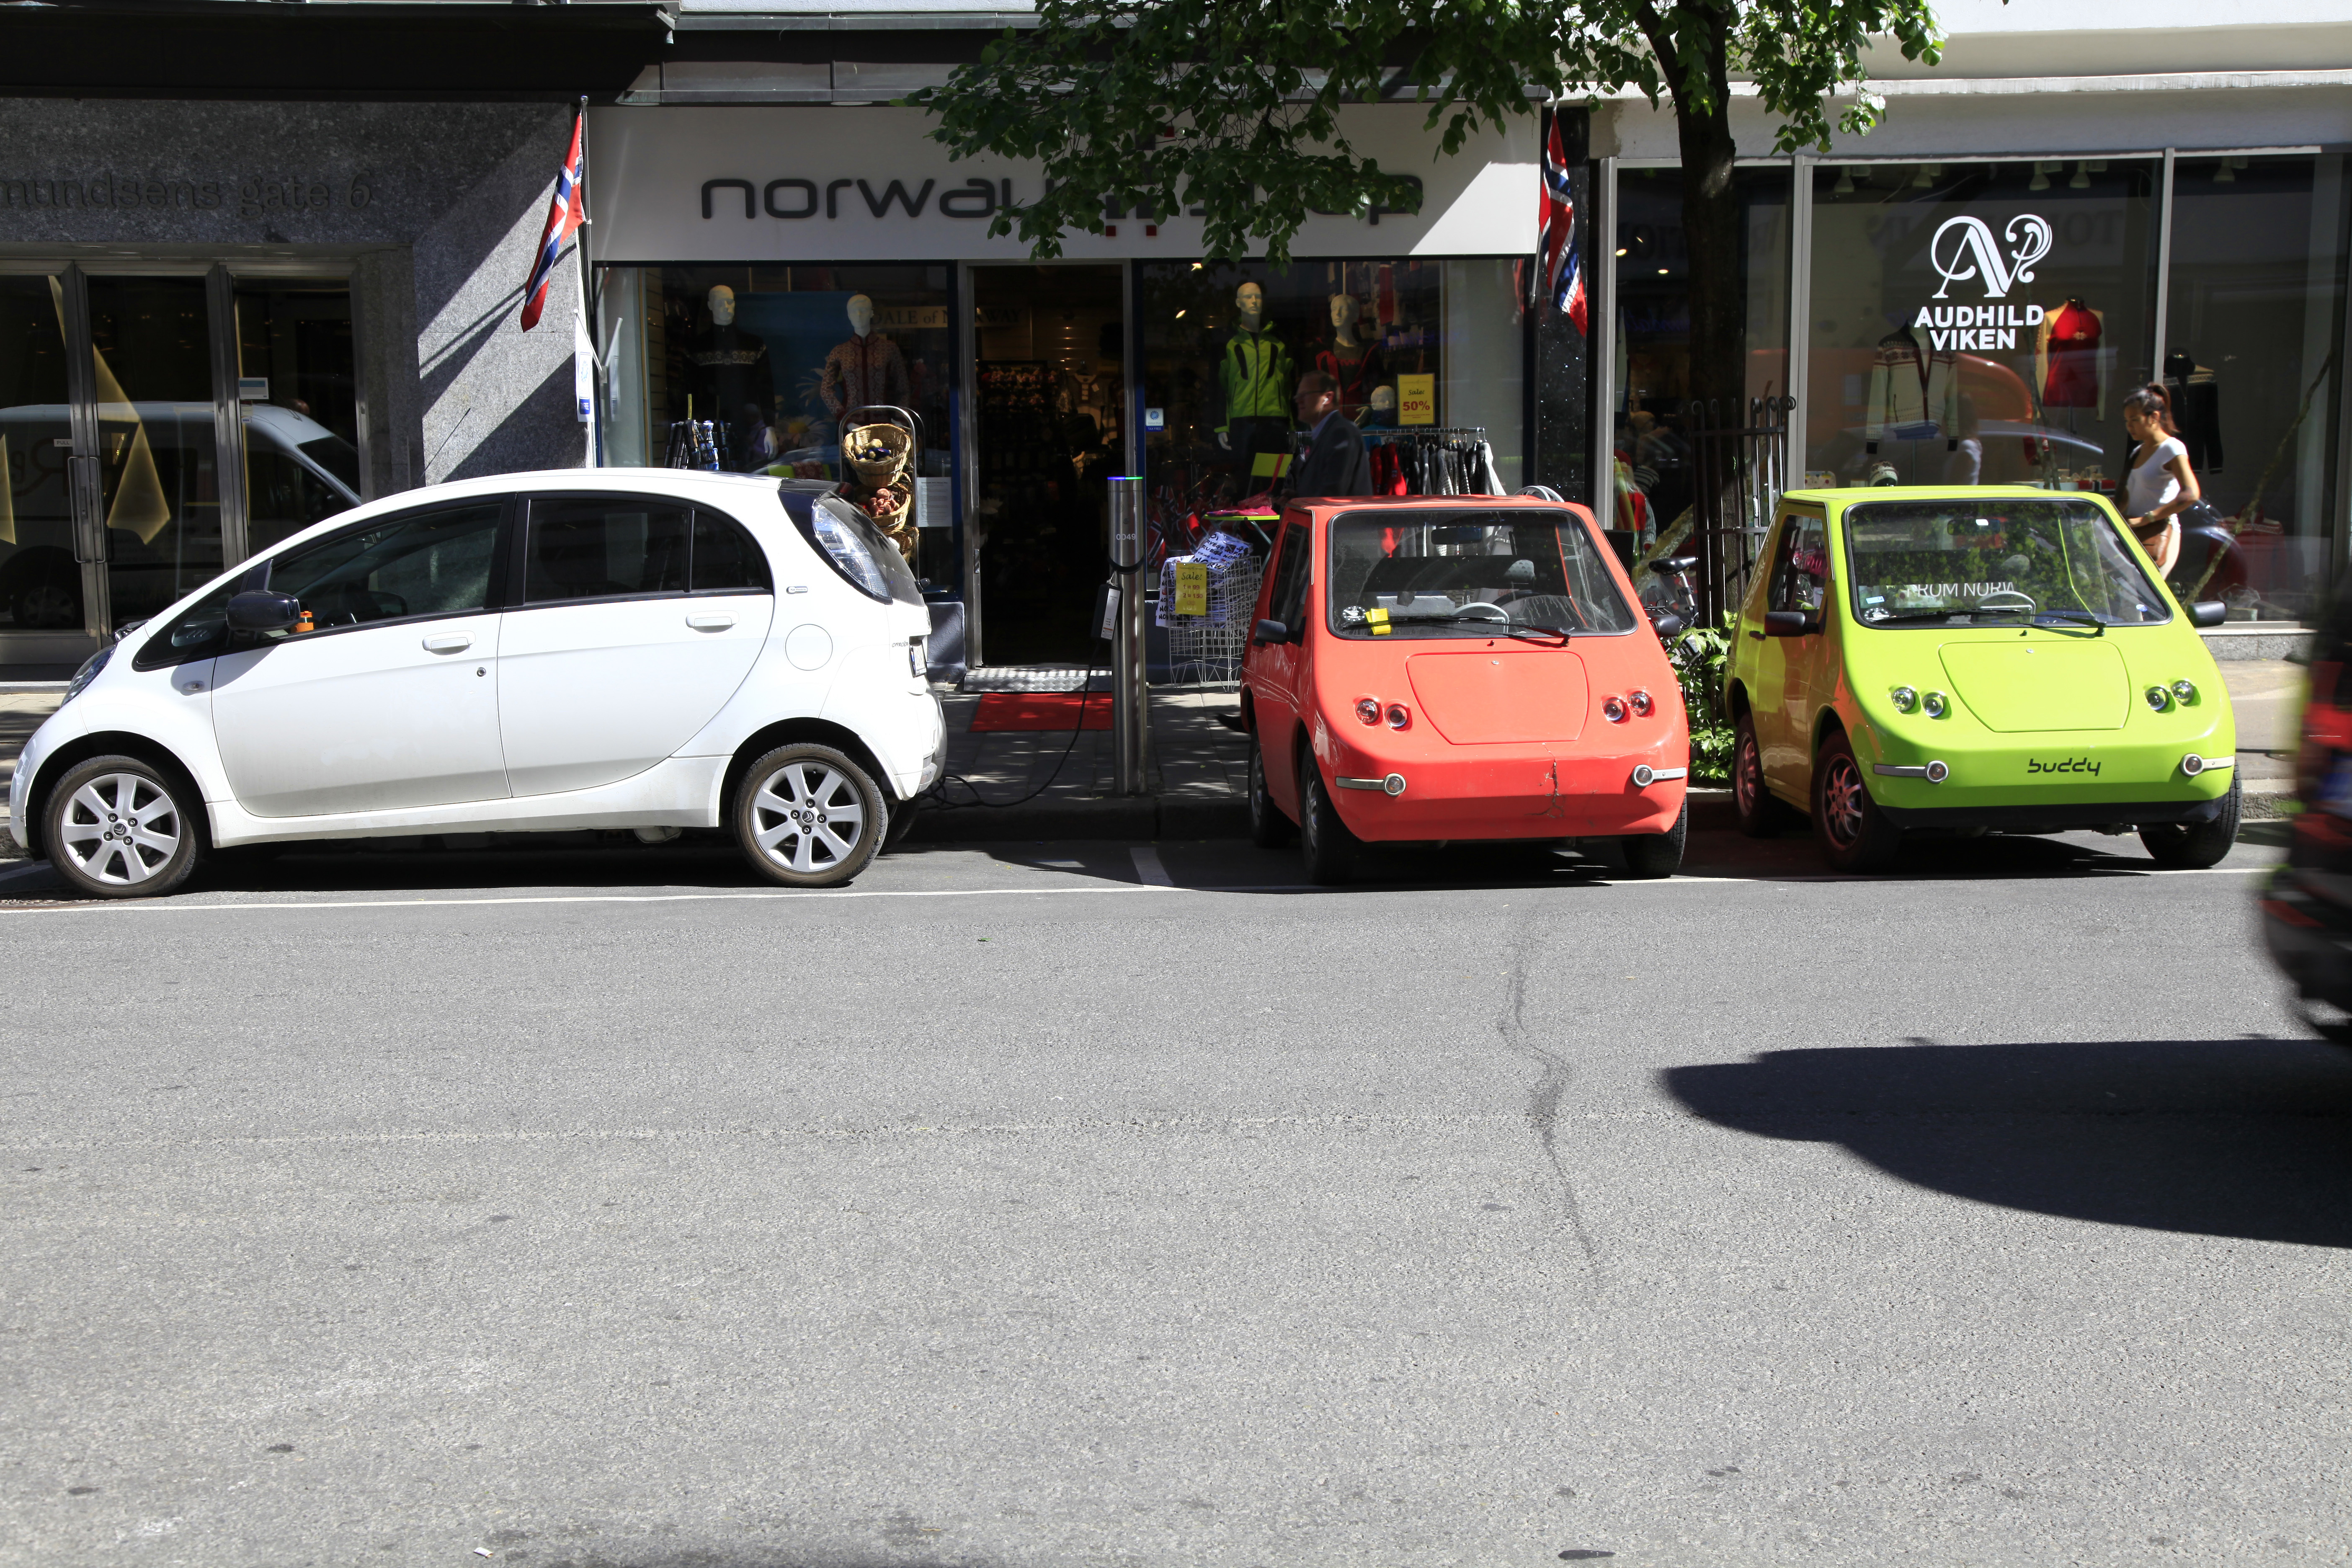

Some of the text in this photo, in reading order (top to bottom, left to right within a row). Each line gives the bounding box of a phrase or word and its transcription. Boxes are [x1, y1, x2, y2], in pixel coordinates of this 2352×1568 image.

[237, 176, 330, 218] gate
[344, 170, 371, 210] 6
[923, 310, 936, 324] of
[1914, 304, 2044, 328] AUDHILD
[1930, 328, 2016, 351] VIKEN
[1403, 400, 1430, 411] 50%
[2027, 757, 2101, 776] buddy
